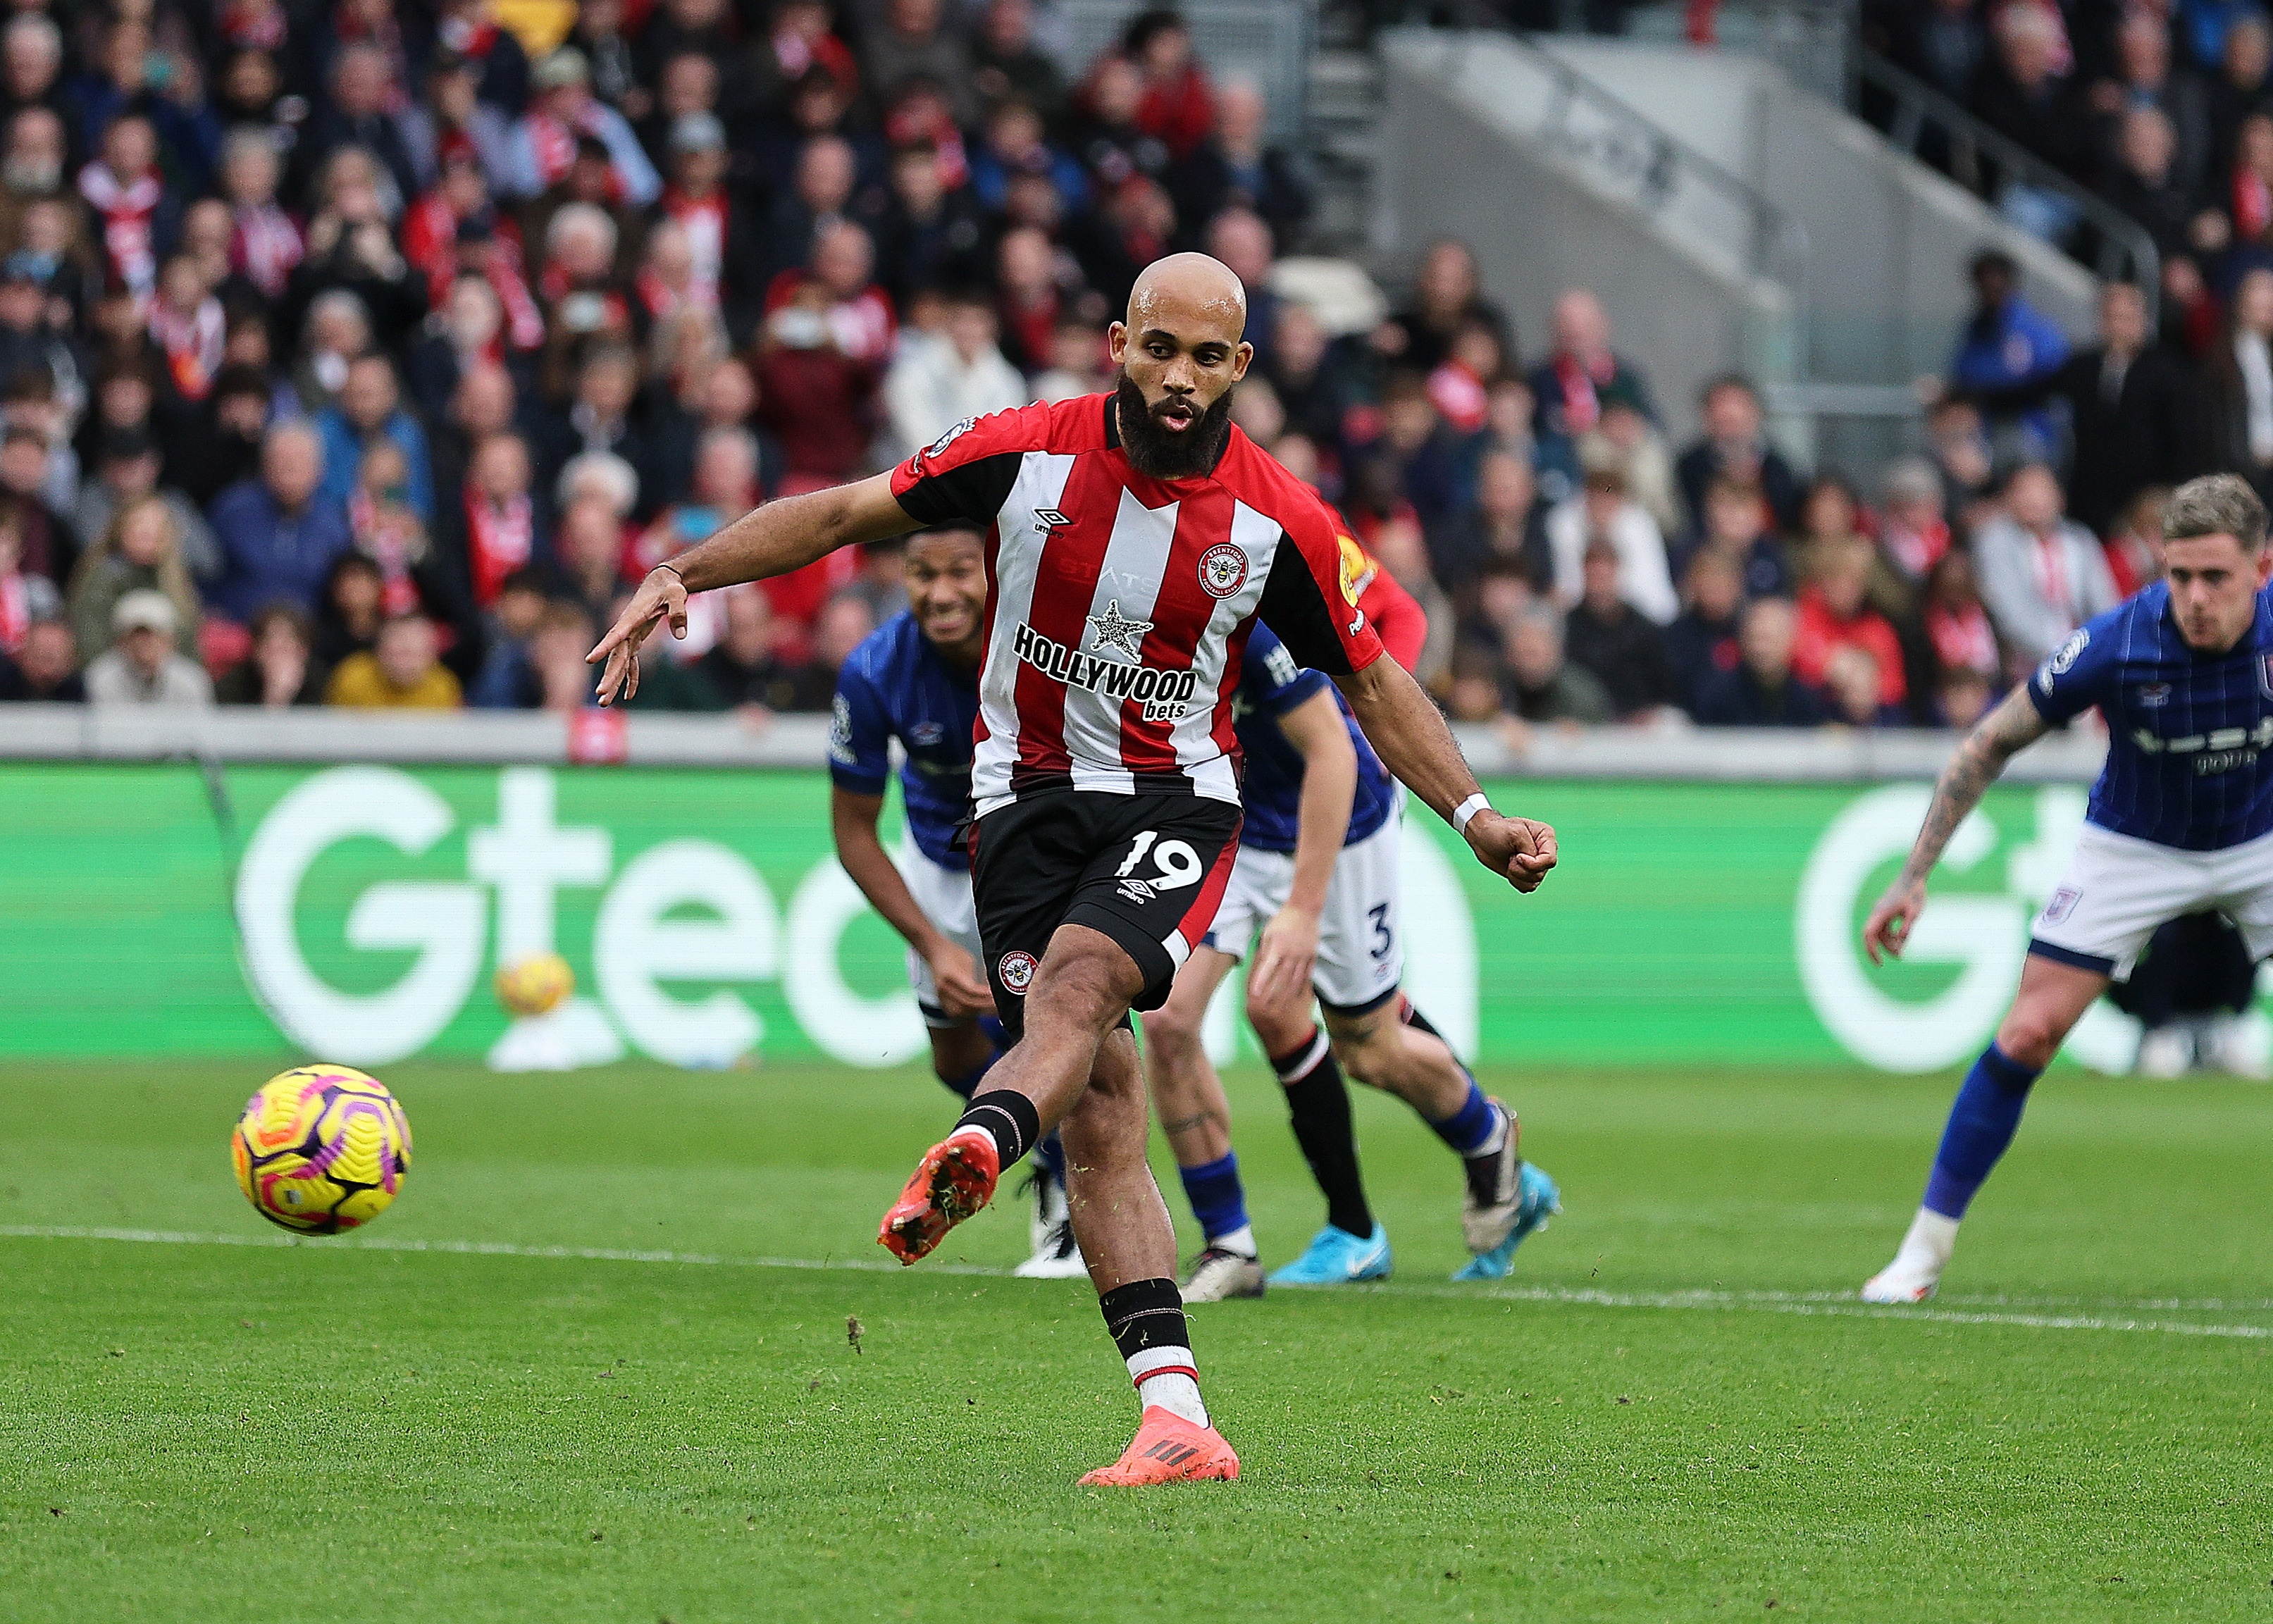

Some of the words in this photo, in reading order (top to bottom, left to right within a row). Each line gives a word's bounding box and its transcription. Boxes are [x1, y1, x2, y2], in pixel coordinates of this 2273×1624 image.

[1034, 523, 1065, 540] umbro
[1208, 547, 1244, 564] BRENTFORD
[1012, 621, 1199, 703] HOLLYWOOD
[1143, 700, 1188, 721] bets
[1113, 830, 1203, 891] 19
[1116, 887, 1144, 905] umbro
[1368, 902, 1391, 959] 3
